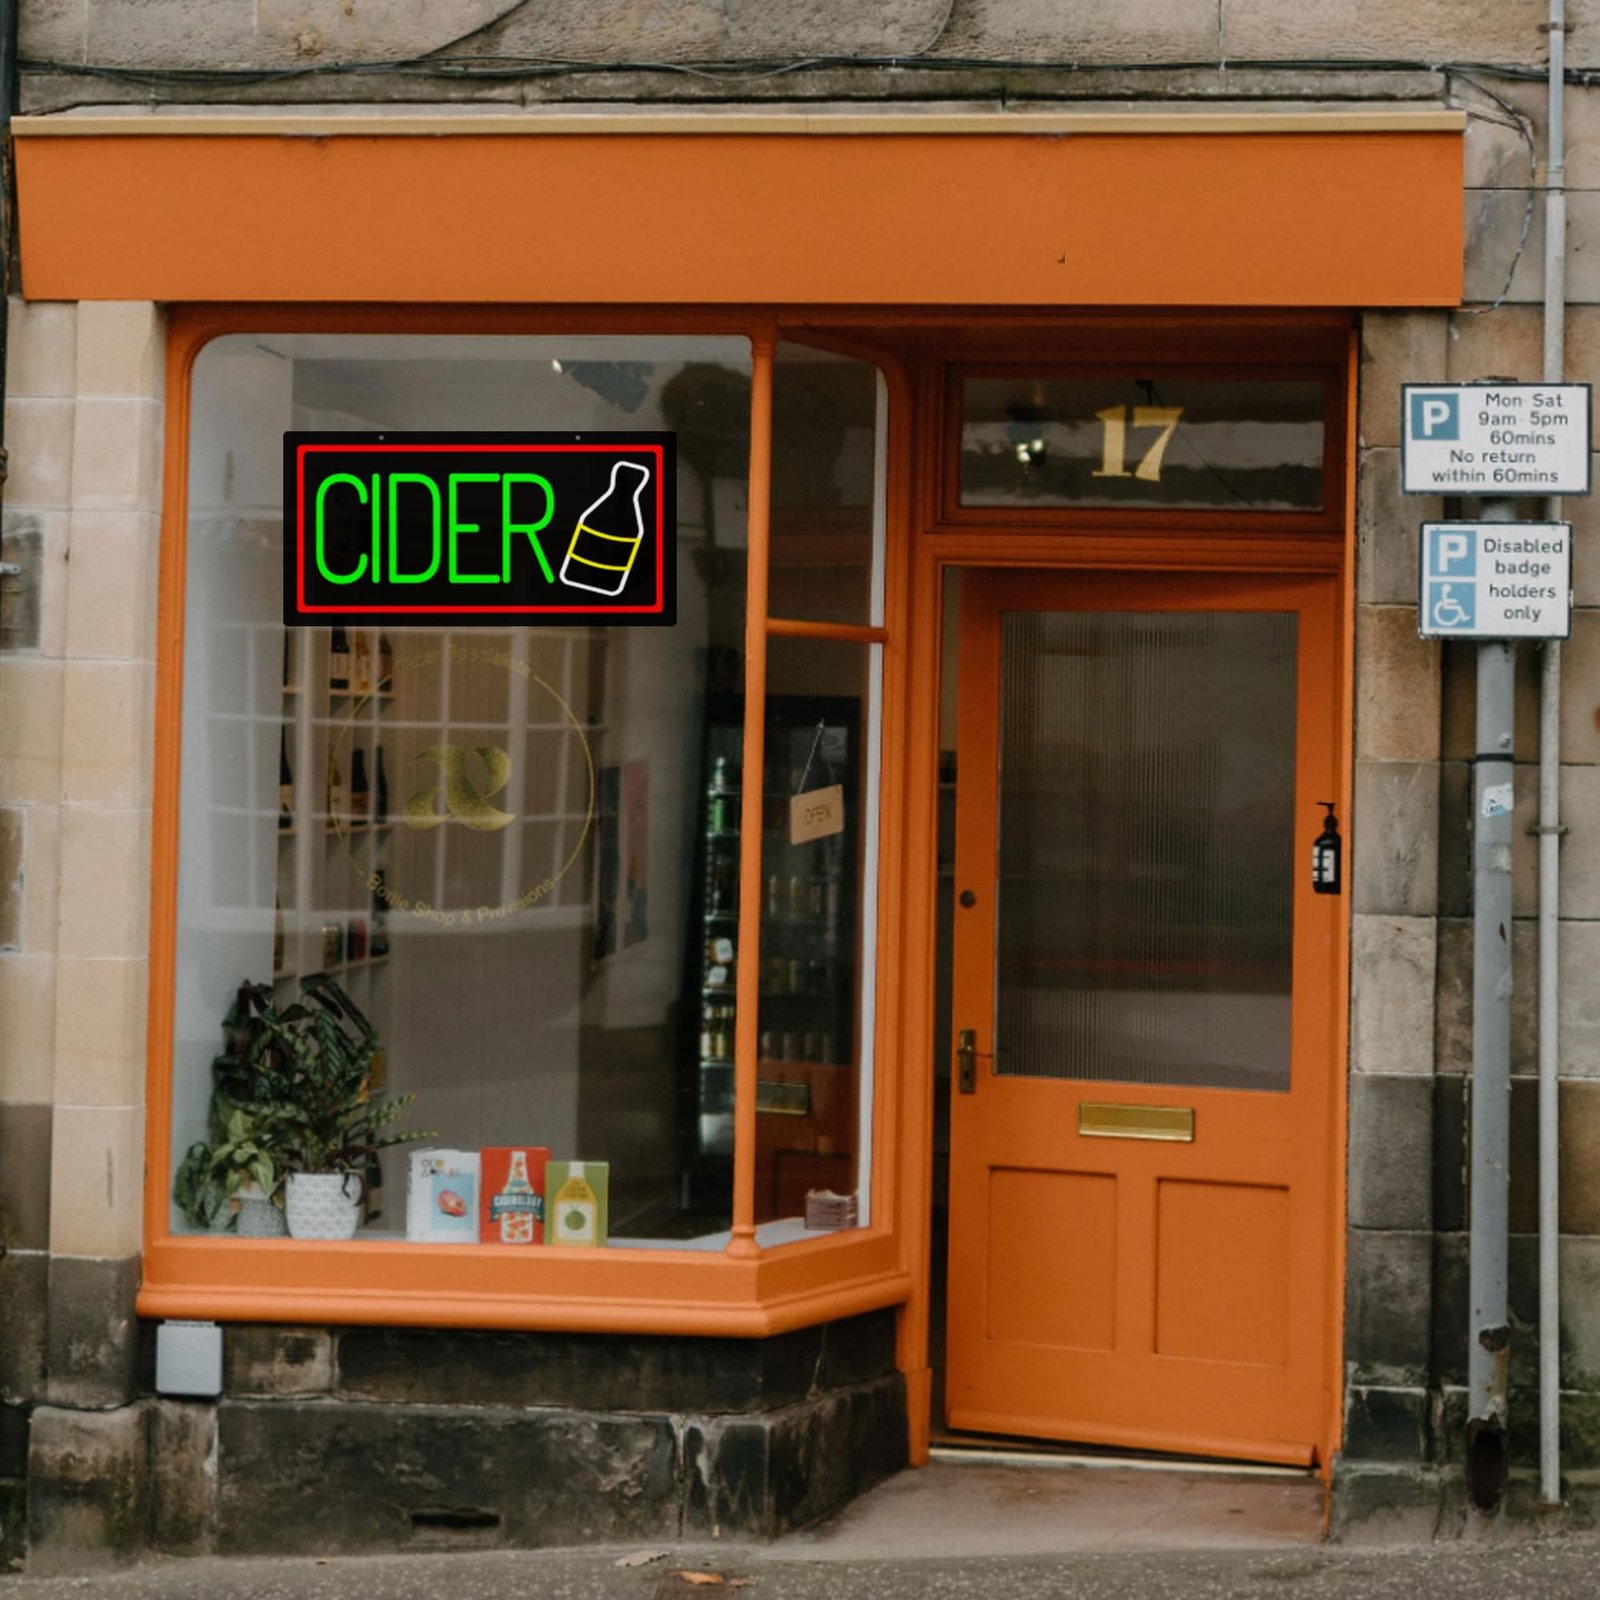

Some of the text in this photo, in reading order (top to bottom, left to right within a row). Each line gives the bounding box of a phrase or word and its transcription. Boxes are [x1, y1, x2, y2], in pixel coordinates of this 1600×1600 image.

[1485, 393, 1563, 407] Mon Sat
[1423, 400, 1450, 437] P
[1478, 411, 1568, 427] 9am 5pm
[1092, 404, 1185, 483] 17
[1490, 431, 1556, 445] 60mins
[1450, 450, 1536, 464] No return
[1432, 468, 1559, 483] within 60mins
[316, 473, 555, 584] CIDER
[1438, 534, 1467, 572] P
[1484, 538, 1563, 554] Disabled
[1495, 561, 1551, 575] badge
[1489, 584, 1556, 599] holders
[1503, 606, 1542, 622] only
[804, 803, 832, 826] OPEN
[413, 902, 456, 926] Shop
[461, 910, 471, 924] &
